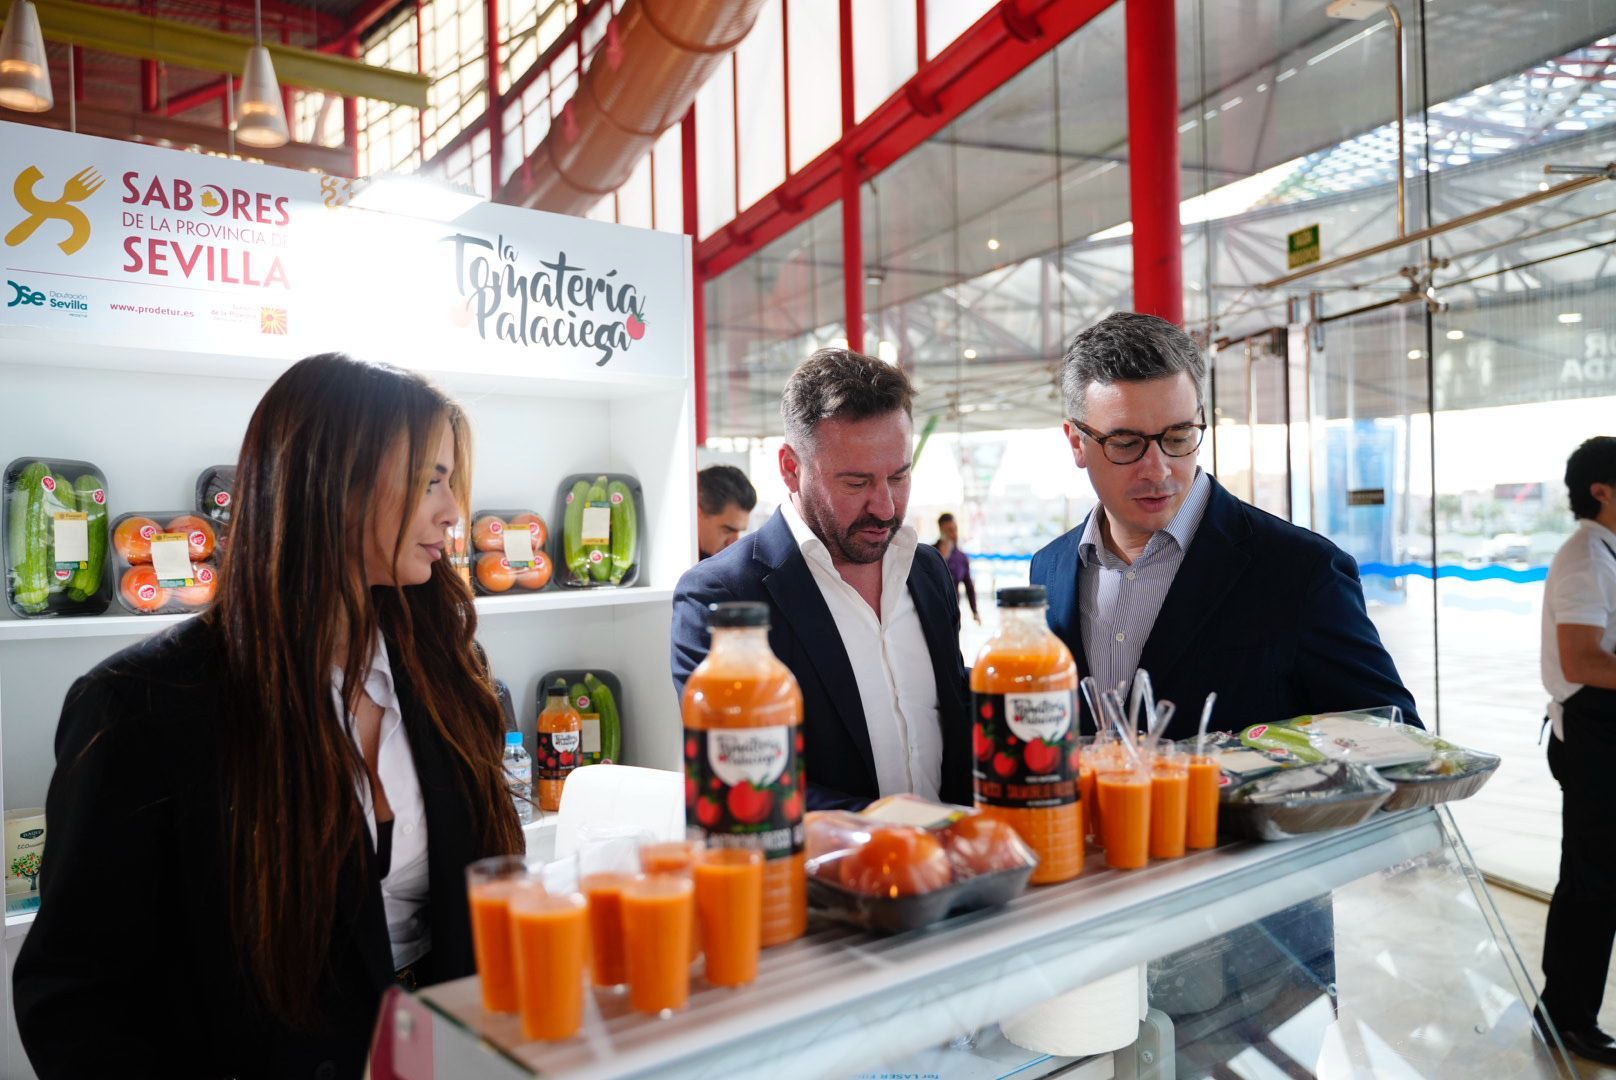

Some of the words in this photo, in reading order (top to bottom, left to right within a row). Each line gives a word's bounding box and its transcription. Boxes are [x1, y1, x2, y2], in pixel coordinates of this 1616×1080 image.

[122, 171, 290, 225] SABORES
[123, 212, 144, 230] DE
[150, 215, 171, 233] LA
[176, 219, 265, 243] PROVINCIA
[498, 235, 518, 262] la
[123, 236, 291, 289] SEVILLA
[438, 233, 646, 313] Tomatería
[50, 298, 88, 310] Sevilla
[109, 302, 195, 318] www.prodetur.es
[465, 289, 632, 367] Palaciega
